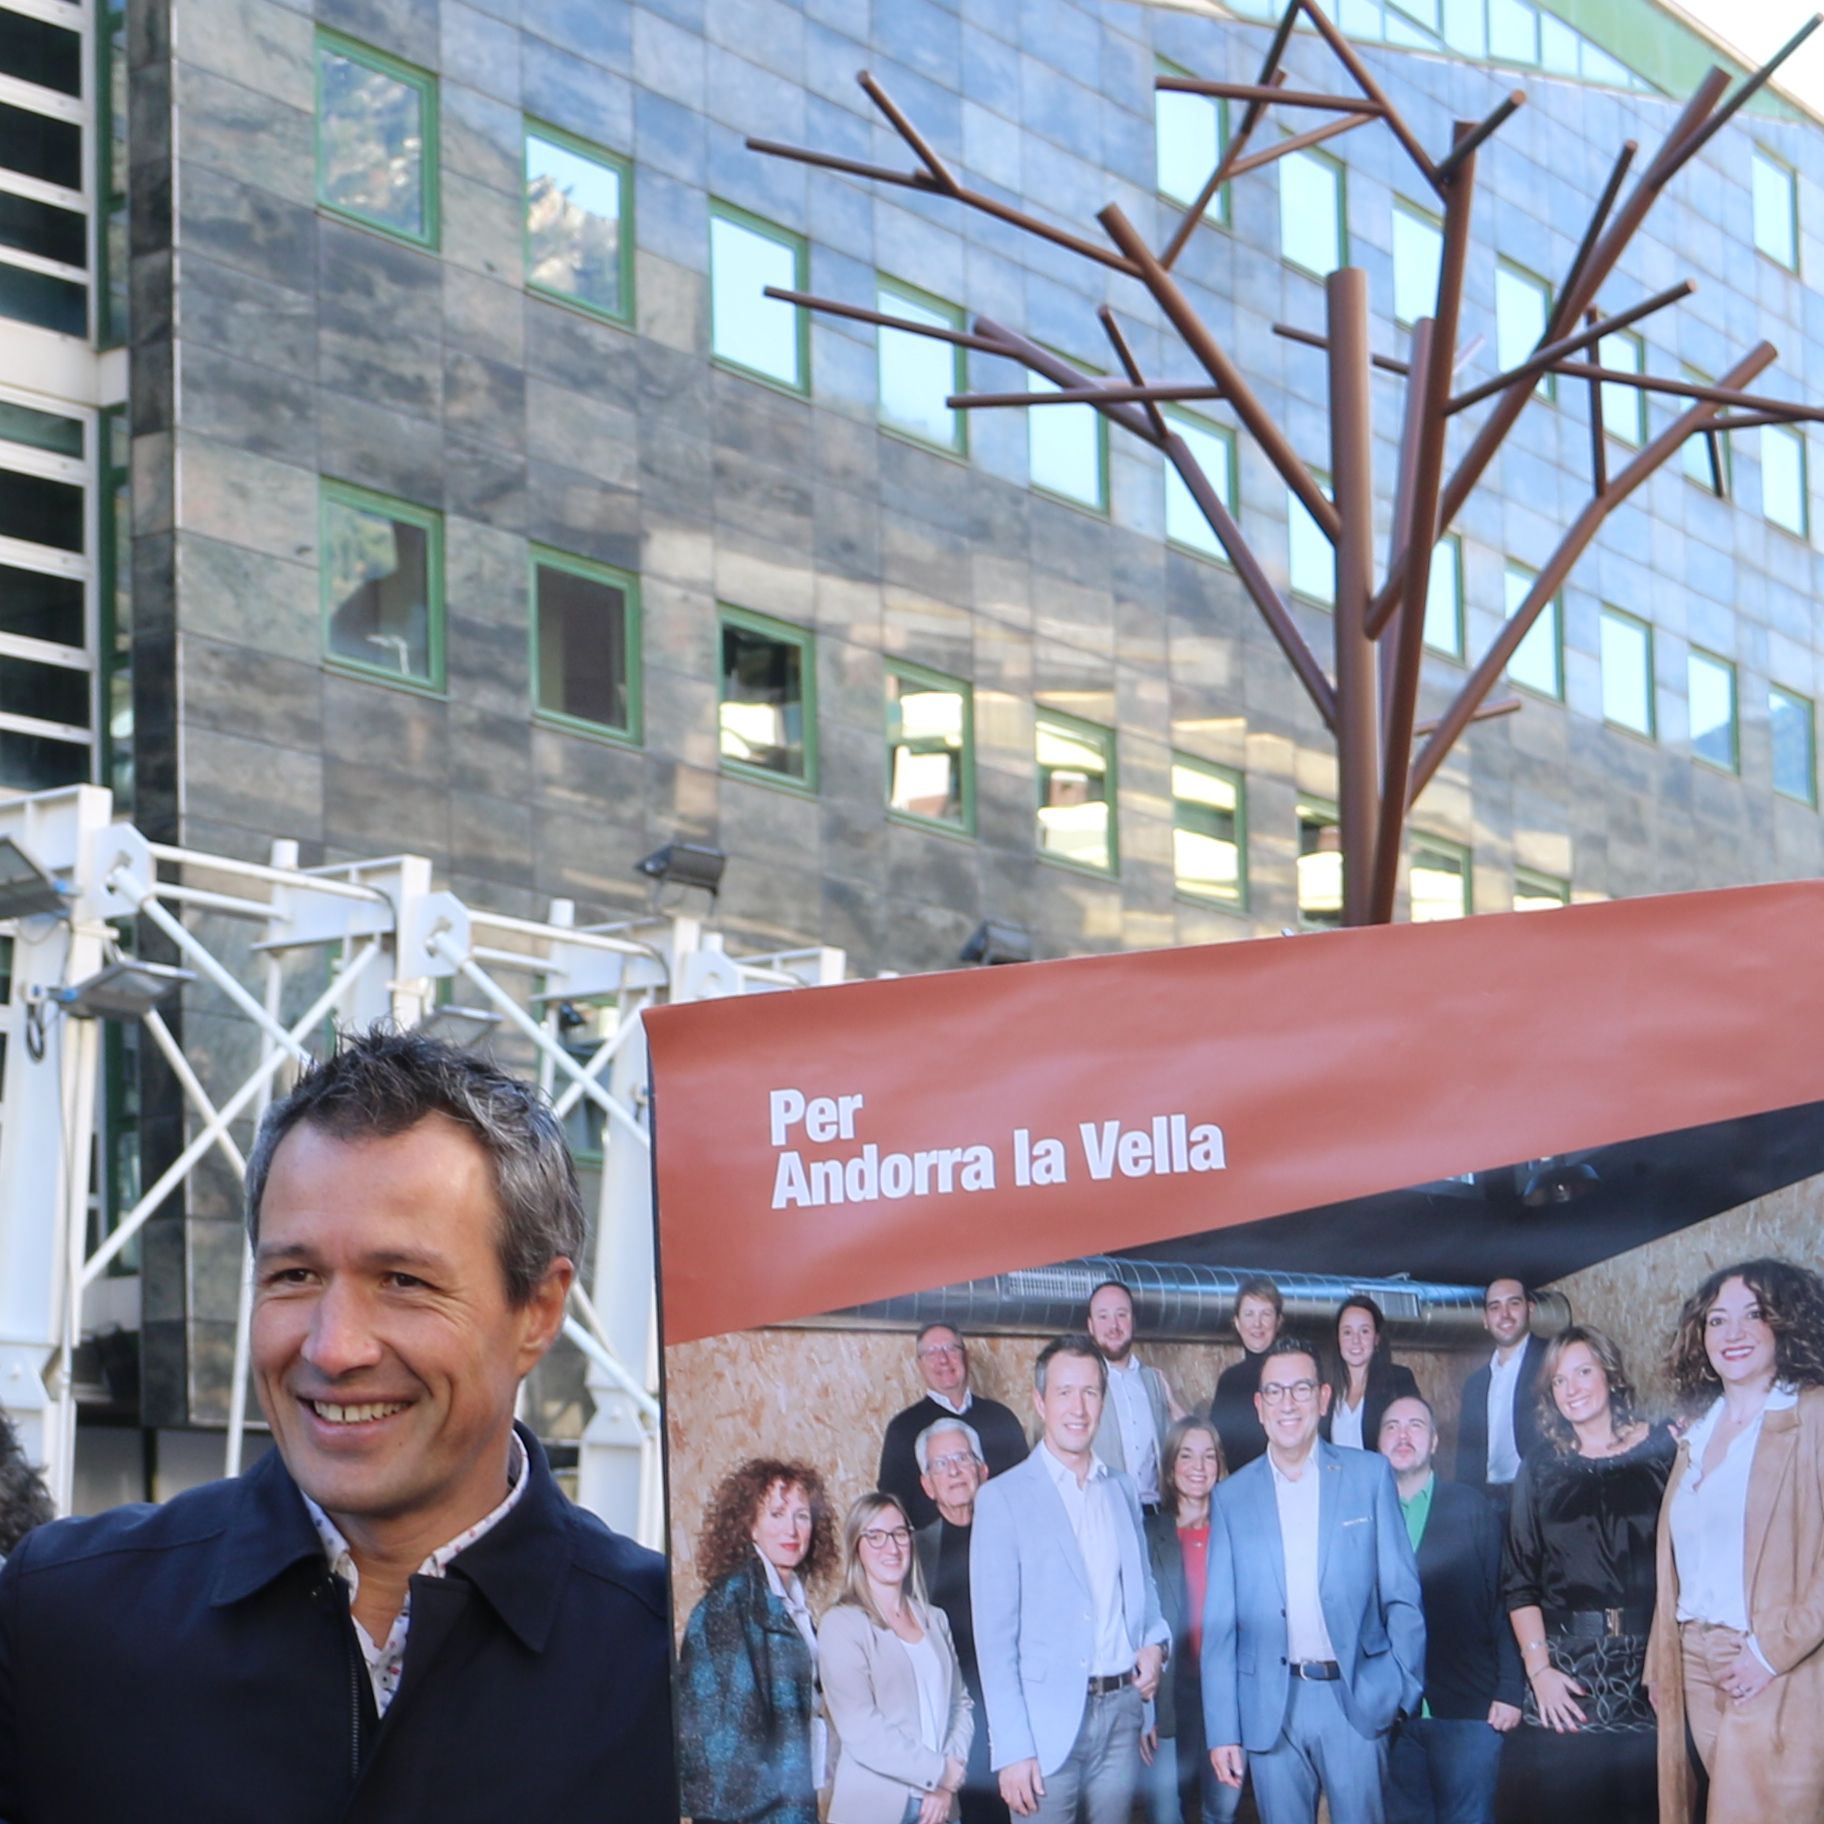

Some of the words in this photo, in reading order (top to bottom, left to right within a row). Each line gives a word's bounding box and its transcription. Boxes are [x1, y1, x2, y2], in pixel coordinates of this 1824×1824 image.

[769, 1088, 863, 1146] Per
[771, 1143, 995, 1209] Andorra
[1014, 1129, 1066, 1186] la
[1079, 1114, 1226, 1180] Vella
